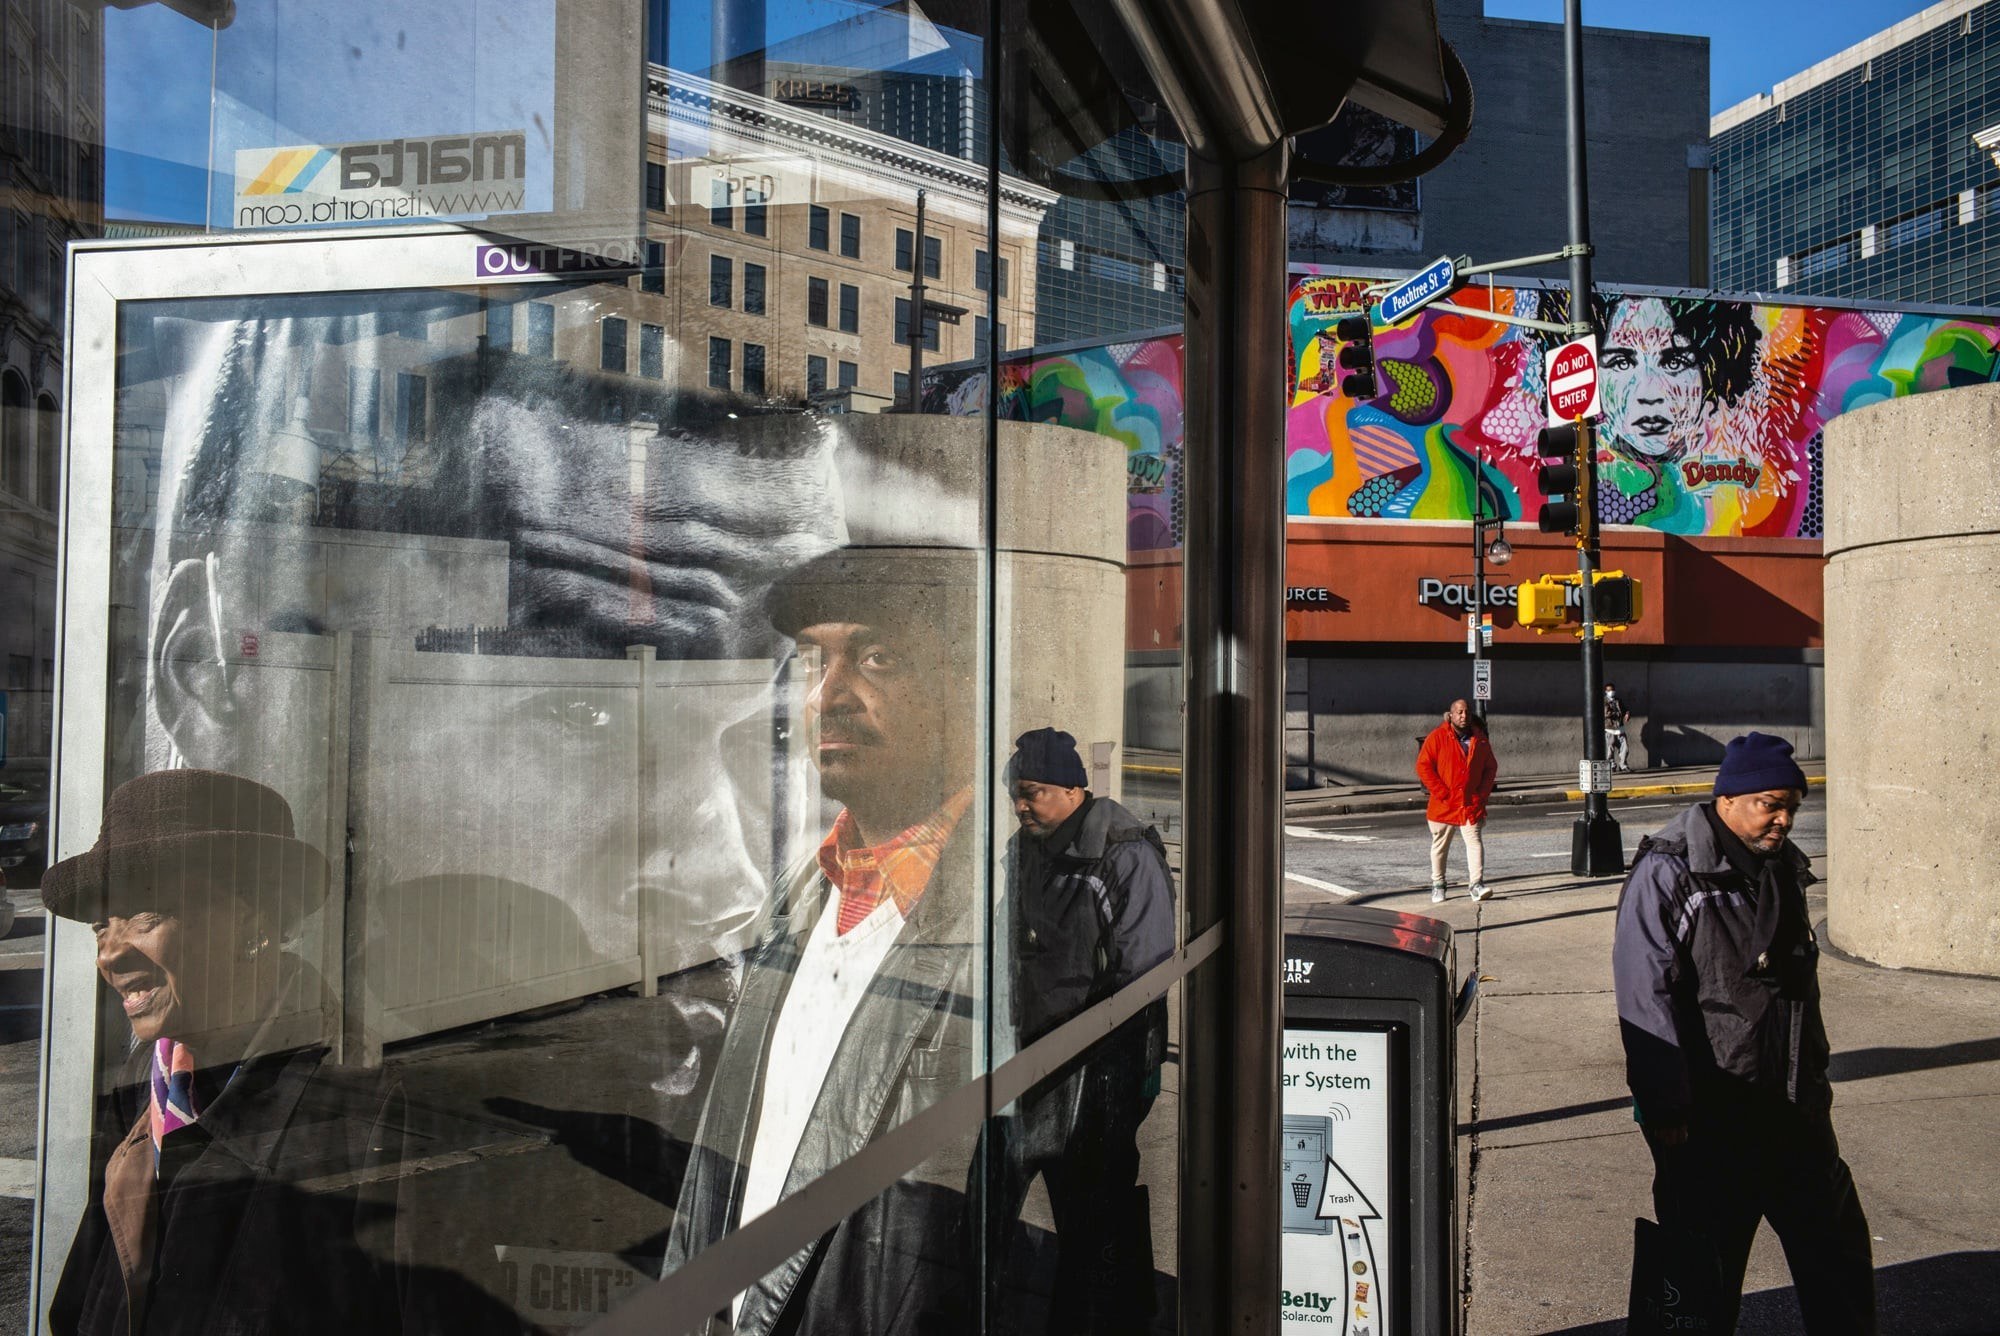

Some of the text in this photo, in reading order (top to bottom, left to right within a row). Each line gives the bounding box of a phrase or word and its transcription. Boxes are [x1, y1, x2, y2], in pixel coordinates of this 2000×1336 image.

[771, 79, 850, 103] KRESS
[1392, 266, 1451, 312] Peachtree St SW
[1557, 353, 1589, 376] DO NOT
[1559, 389, 1588, 409] ENTER
[1682, 458, 1760, 489] Dandy
[1420, 578, 1518, 611] Payles
[1284, 1043, 1357, 1061] with the
[1305, 1072, 1370, 1092] System
[1329, 1194, 1354, 1204] Trash
